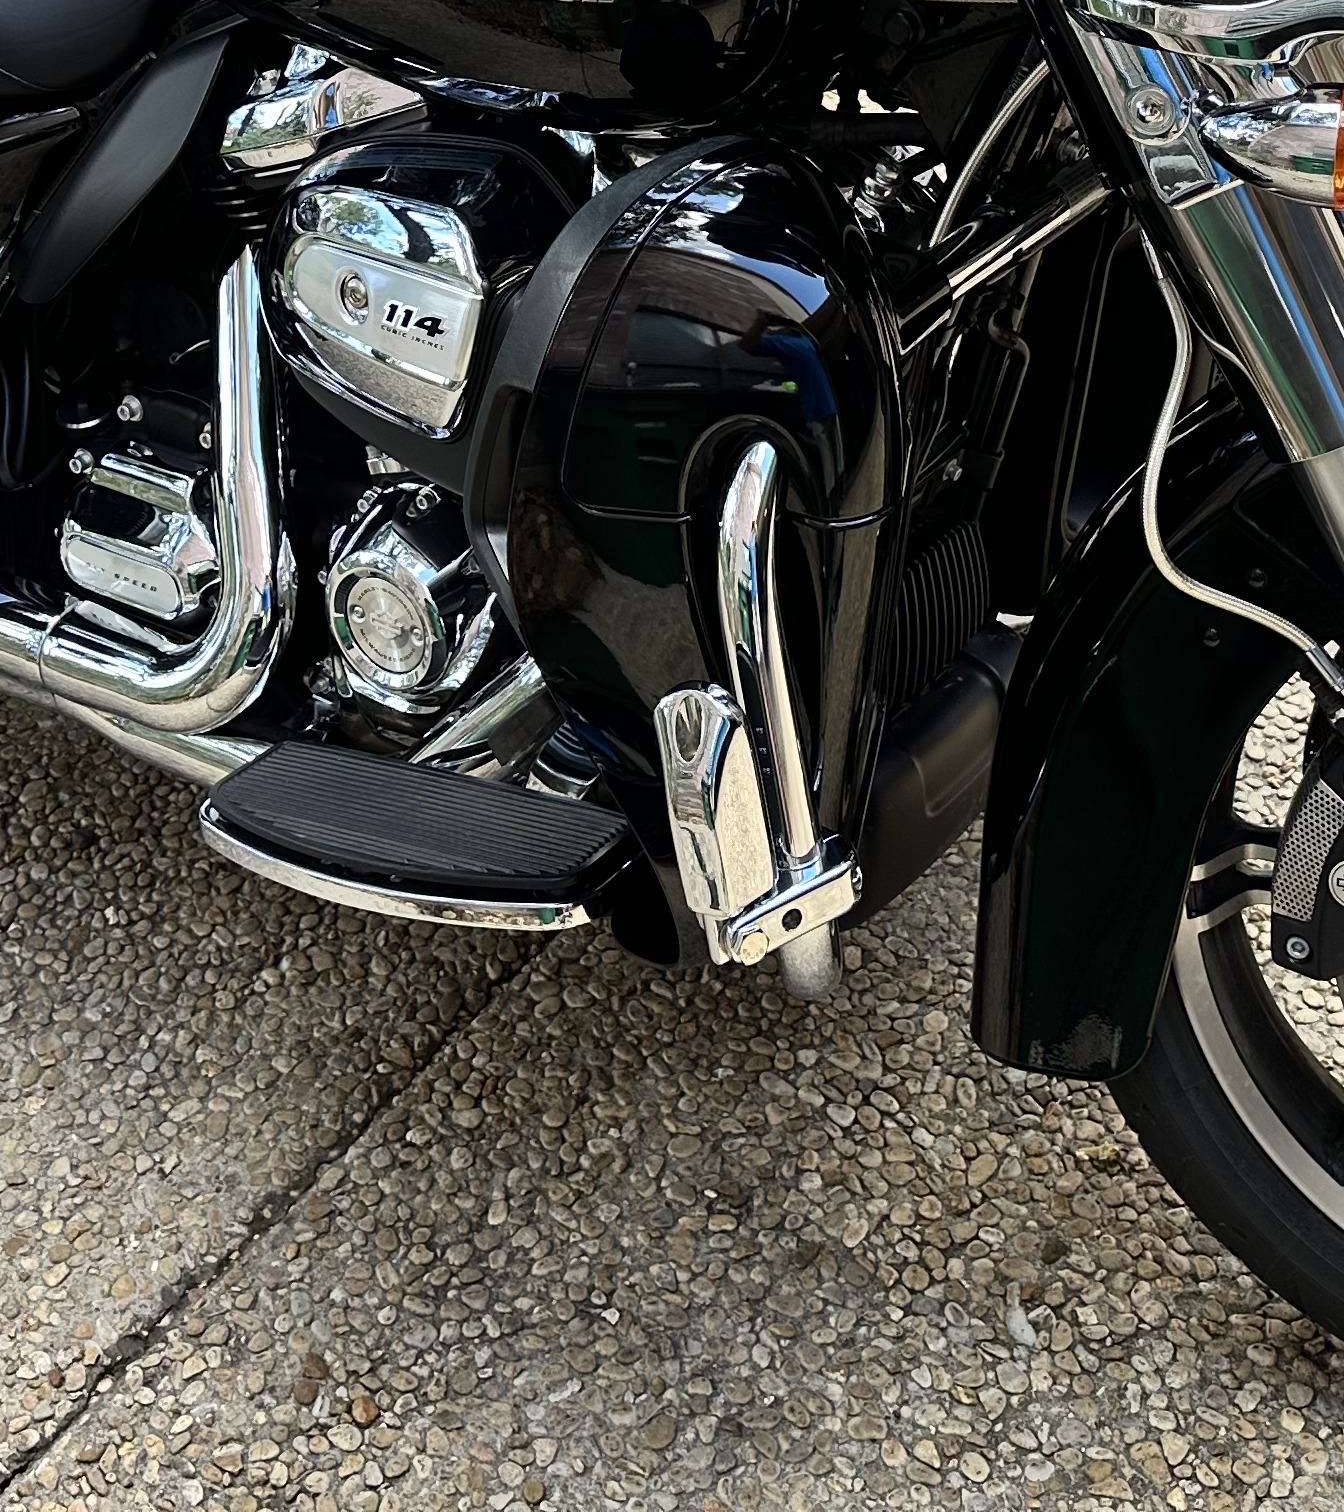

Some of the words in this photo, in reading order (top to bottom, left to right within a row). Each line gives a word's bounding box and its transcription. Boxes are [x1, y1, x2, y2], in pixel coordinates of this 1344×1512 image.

[383, 301, 448, 338] 114
[380, 324, 408, 338] CUBIC
[410, 335, 445, 351] INCHES
[114, 573, 158, 592] SPEED
